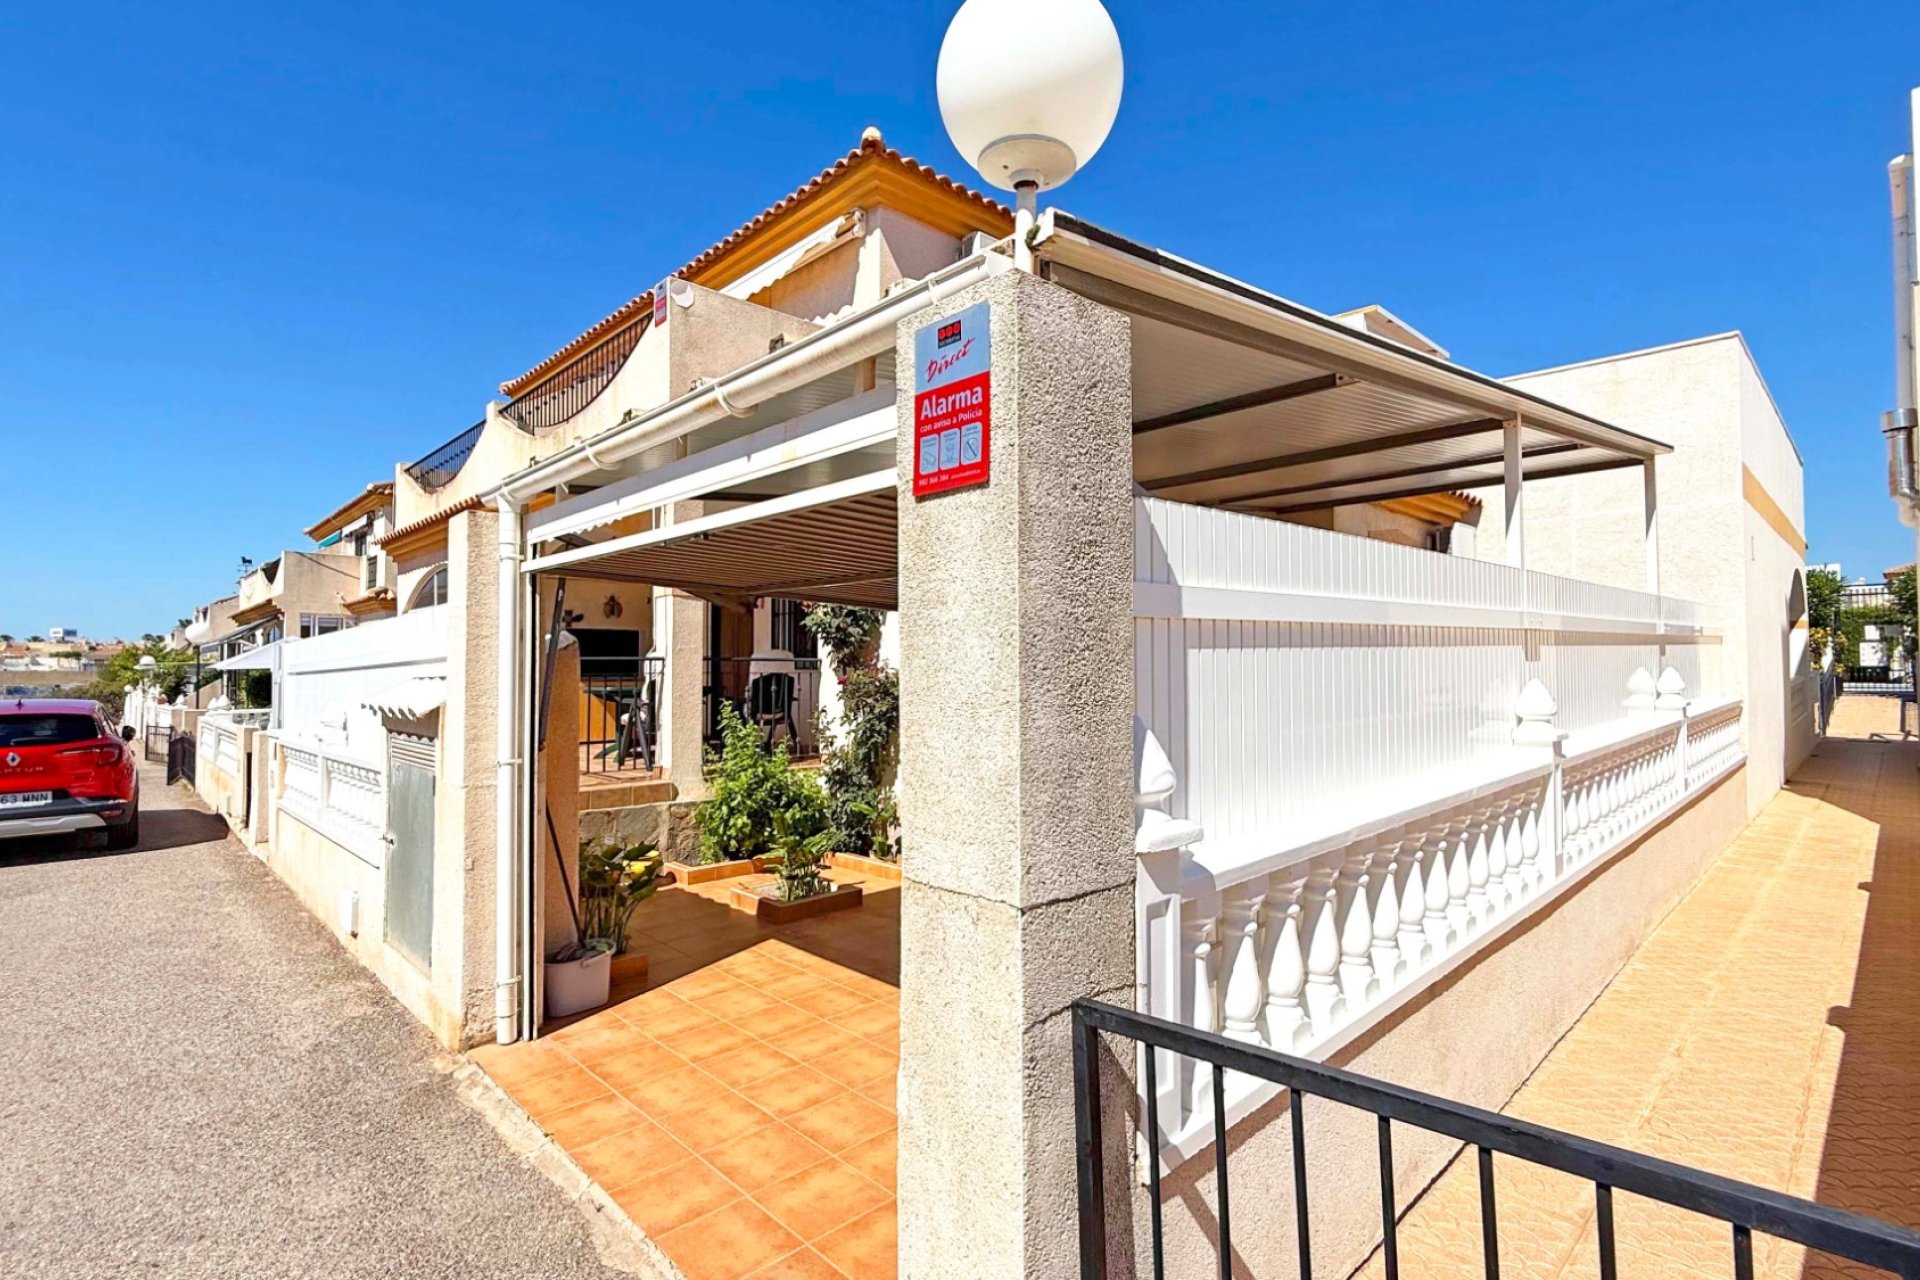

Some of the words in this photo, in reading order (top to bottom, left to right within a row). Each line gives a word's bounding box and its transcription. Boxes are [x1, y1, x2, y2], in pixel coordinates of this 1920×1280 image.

[926, 337, 976, 383] Direct
[920, 386, 983, 420] Alarma
[920, 424, 932, 433] con
[933, 418, 951, 430] aviso
[959, 407, 983, 422] Policía
[0, 795, 17, 804] 63
[23, 793, 48, 802] MNN
